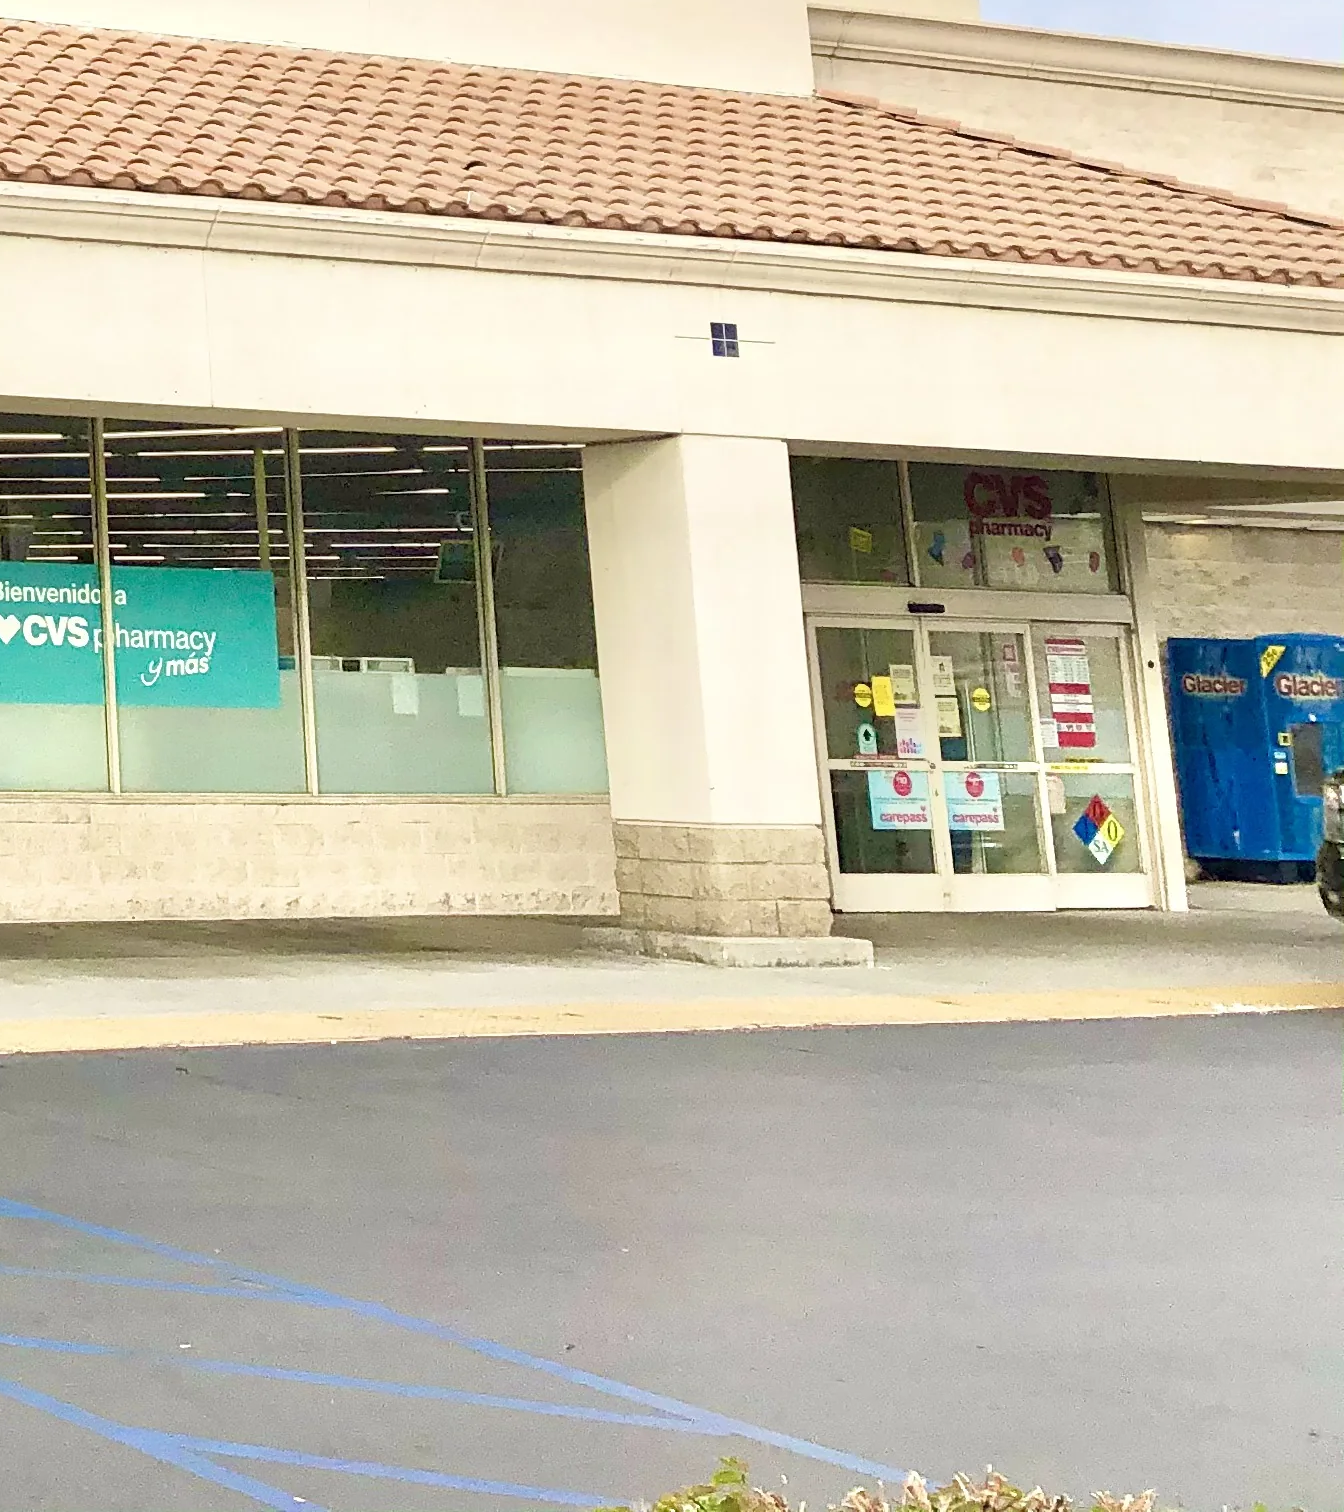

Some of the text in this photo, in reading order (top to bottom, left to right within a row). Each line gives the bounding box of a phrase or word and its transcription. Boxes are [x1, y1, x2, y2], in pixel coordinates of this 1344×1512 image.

[964, 471, 1053, 519] CVS
[969, 519, 1053, 541] pharmacy
[114, 589, 127, 605] a
[22, 614, 217, 656] CVS pharmacy
[140, 651, 210, 686] y más
[1183, 674, 1244, 693] Glacier
[879, 811, 928, 824] carepass
[952, 812, 1000, 826] carepass
[1107, 819, 1118, 842] 0
